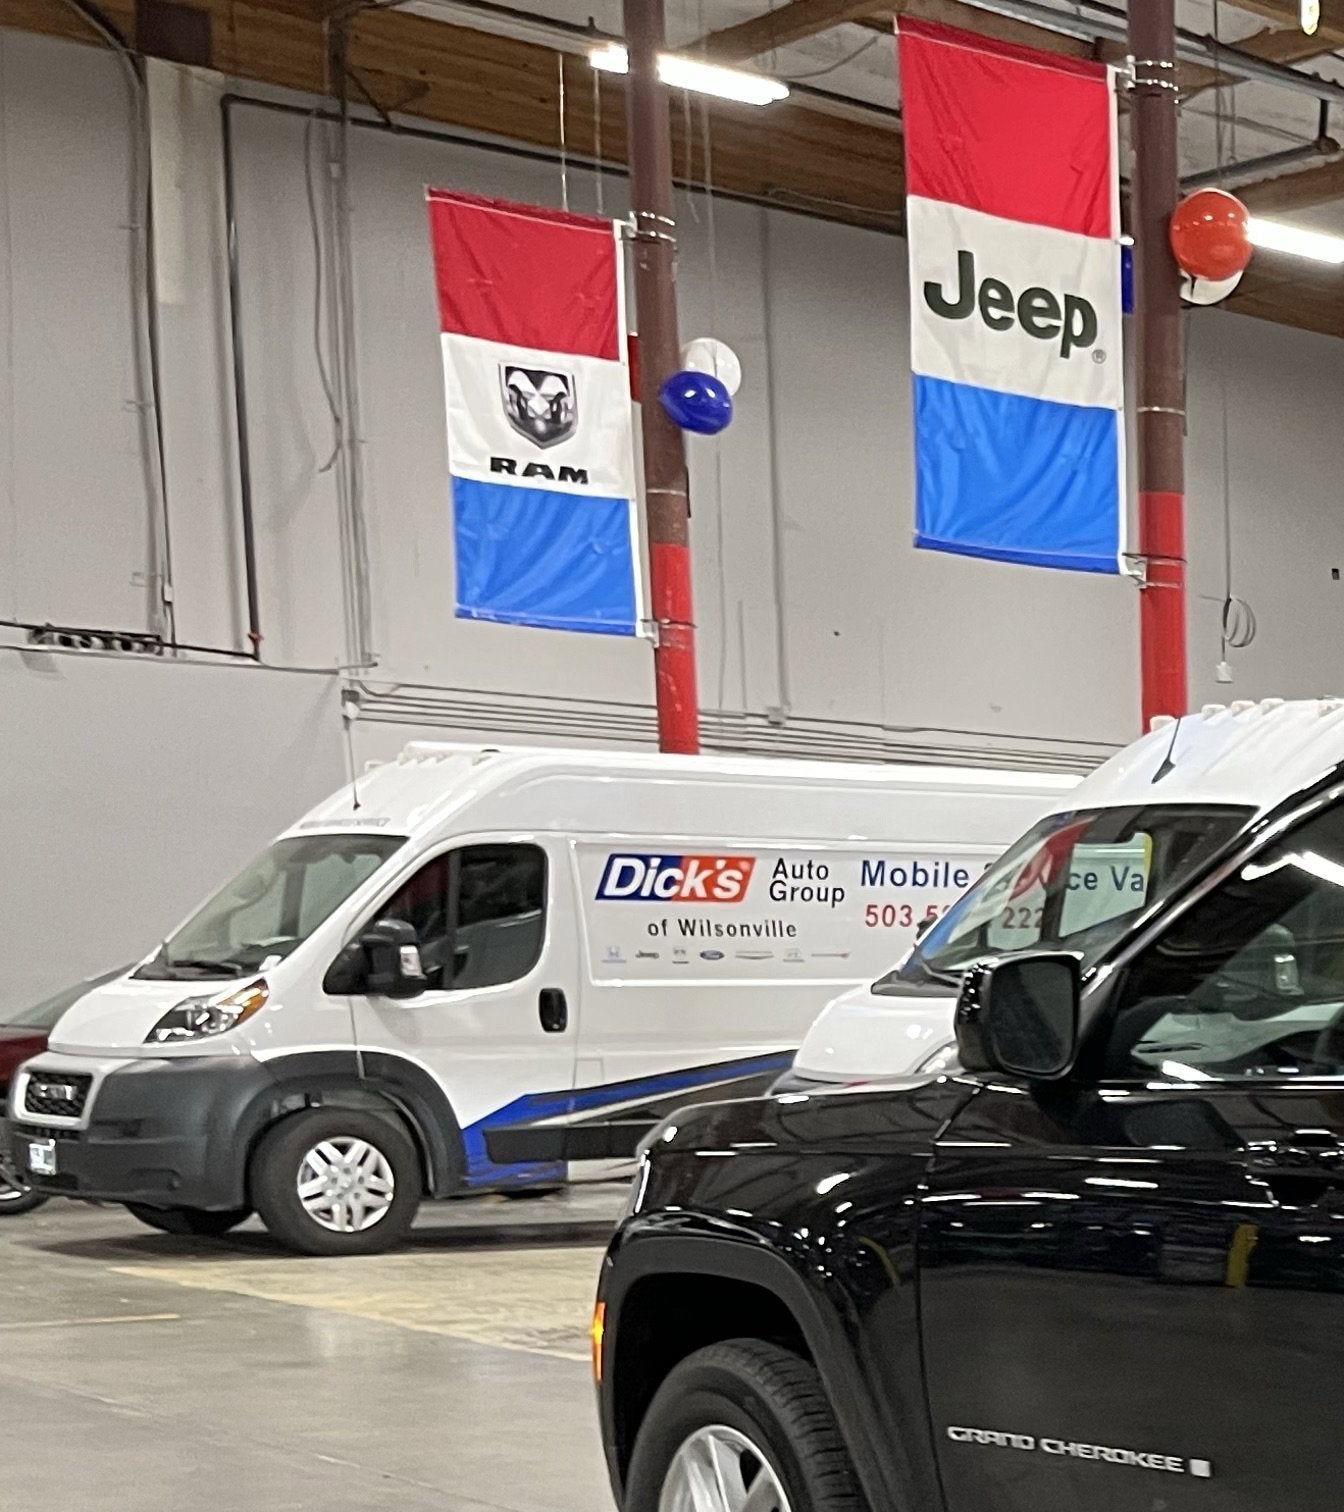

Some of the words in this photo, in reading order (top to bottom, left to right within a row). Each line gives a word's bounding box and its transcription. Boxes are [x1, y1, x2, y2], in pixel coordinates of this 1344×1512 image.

[923, 249, 1098, 360] Jeep
[489, 456, 588, 485] RAM
[603, 857, 744, 899] Dick's
[772, 857, 829, 881] Auto
[860, 860, 970, 888] Mobile
[1110, 865, 1144, 891] Va
[769, 880, 846, 909] Group
[647, 918, 669, 937] of
[677, 918, 798, 938] Wilsonville
[864, 904, 914, 928] 503
[947, 1425, 1036, 1451] GRAND
[1039, 1437, 1185, 1473] CHEROKEE
